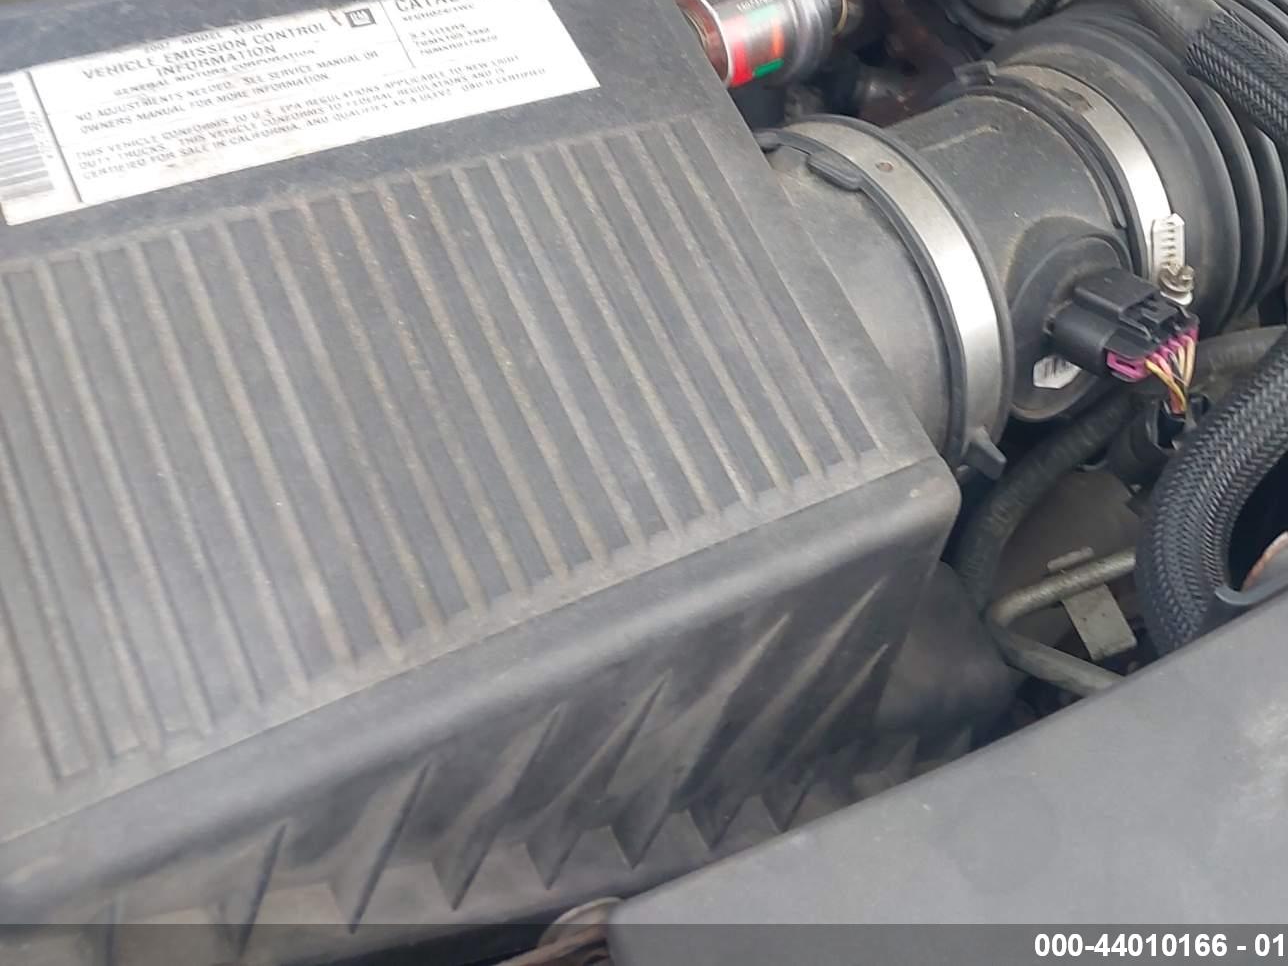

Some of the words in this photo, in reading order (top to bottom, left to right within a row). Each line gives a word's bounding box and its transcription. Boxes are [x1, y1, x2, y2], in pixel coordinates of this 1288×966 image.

[82, 57, 154, 79] VEHICLE
[163, 38, 246, 63] EMISSION
[252, 22, 325, 44] CONTROL
[156, 44, 276, 76] INFORMATION
[97, 92, 182, 116] ADJUSTMENTS
[267, 64, 312, 80] SERVICE
[316, 54, 359, 68] MANUAL
[135, 105, 184, 120] MANUAL
[215, 90, 248, 102] MORE
[251, 73, 328, 94] INFORMATION
